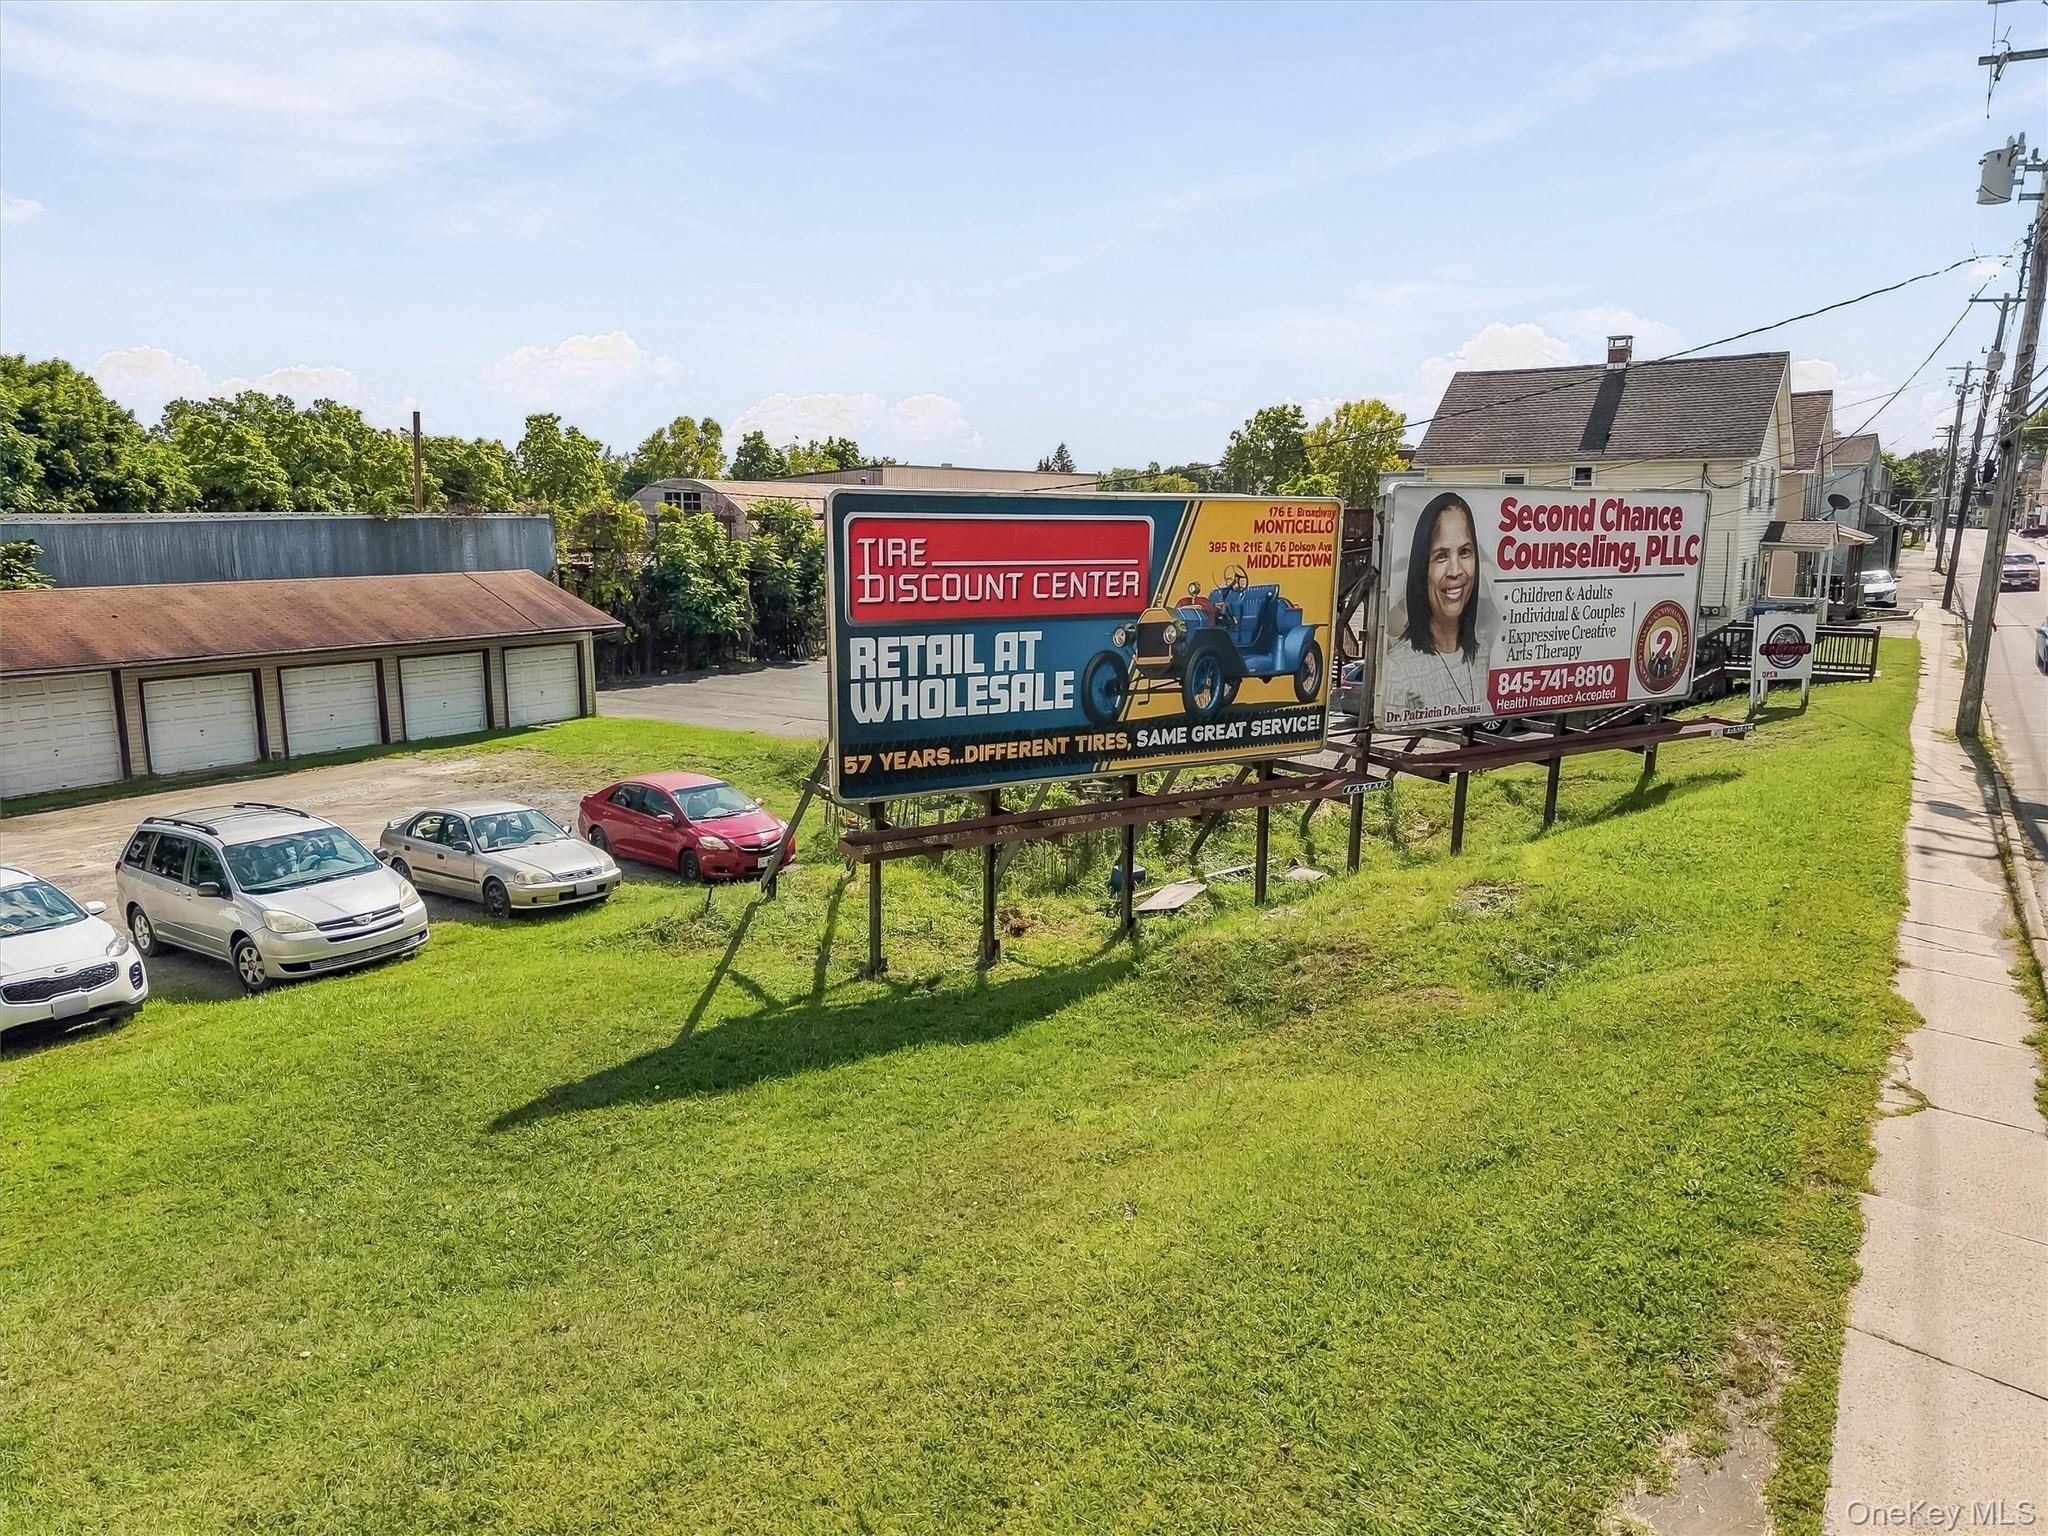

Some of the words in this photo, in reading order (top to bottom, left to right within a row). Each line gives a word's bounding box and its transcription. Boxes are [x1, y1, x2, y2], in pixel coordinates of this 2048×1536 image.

[1269, 507, 1284, 517] 176
[1287, 507, 1293, 517] E
[1297, 507, 1336, 520] Broadway
[1498, 497, 1597, 532] Second
[1600, 498, 1683, 532] Chance
[1254, 519, 1334, 533] MONTICELLO
[857, 538, 927, 567] TIRE
[1209, 542, 1227, 552] 395
[1230, 542, 1240, 552] Rt
[1243, 542, 1263, 552] 211E
[1265, 542, 1272, 553] &
[1274, 541, 1286, 552] 76
[1289, 541, 1316, 552] Dolson
[1318, 542, 1333, 552] Ave
[1497, 535, 1640, 573] Counseling,
[1645, 534, 1700, 566] PLLC
[1247, 553, 1332, 568] MIDDLETOWN
[857, 572, 1023, 603] DISCOUNT
[1033, 571, 1139, 599] CENTER
[1511, 587, 1562, 604] Children
[1565, 586, 1574, 600] &
[1577, 584, 1613, 600] Adults
[1509, 606, 1568, 624] Individual
[1571, 606, 1580, 620] &
[1583, 603, 1625, 622] Couples
[1508, 626, 1570, 646] Expressive
[1572, 623, 1616, 639] Creative
[850, 634, 985, 679] RETAIL
[995, 631, 1042, 671] AT
[1506, 645, 1532, 662] Arts
[1535, 643, 1582, 660] Therapy
[1498, 664, 1614, 695] 845-741-8810
[850, 671, 1075, 724] WHOLESALE
[1497, 696, 1527, 710] Health
[1530, 691, 1573, 707] Insurance
[1575, 687, 1616, 702] Accepted
[1387, 712, 1401, 722] Dr.
[1403, 706, 1441, 721] Patricia
[1444, 704, 1480, 717] DeJesus
[845, 755, 872, 775] 57
[1075, 732, 1132, 752] TIRES,
[1137, 727, 1187, 747] SAME
[1191, 721, 1247, 742] GREAT
[1251, 714, 1320, 736] SERVICE!
[1347, 781, 1387, 792] LAMAR
